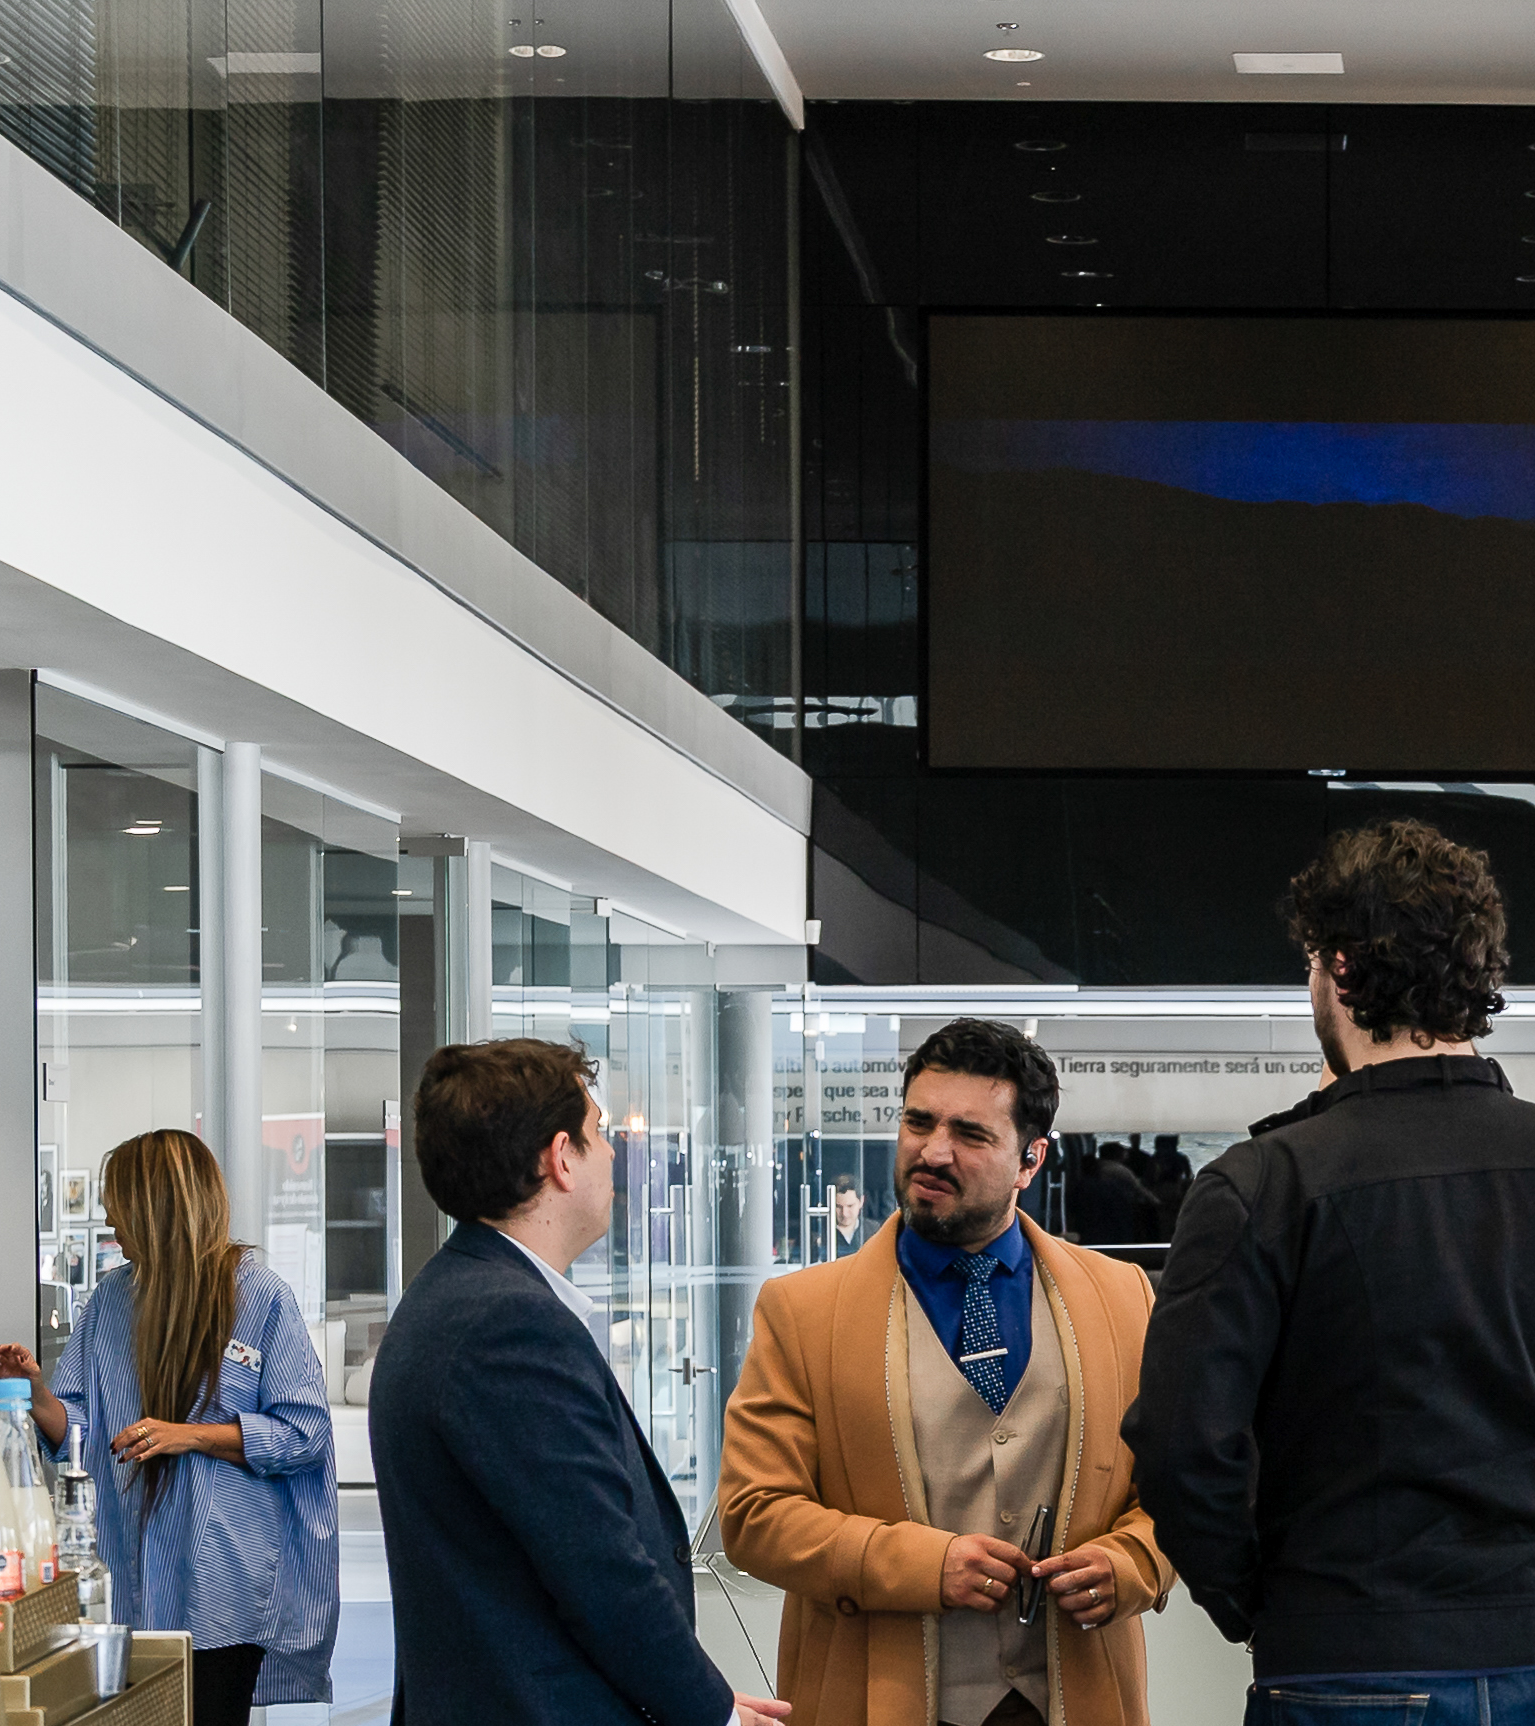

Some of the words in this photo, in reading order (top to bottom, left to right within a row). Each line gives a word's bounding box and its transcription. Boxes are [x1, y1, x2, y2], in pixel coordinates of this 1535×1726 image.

[831, 1057, 906, 1073] automóv
[1057, 1056, 1106, 1074] Tierra
[1110, 1058, 1220, 1078] seguramente
[1224, 1057, 1260, 1074] será
[1264, 1062, 1285, 1074] un
[824, 1085, 856, 1102] que
[861, 1085, 889, 1098] sea
